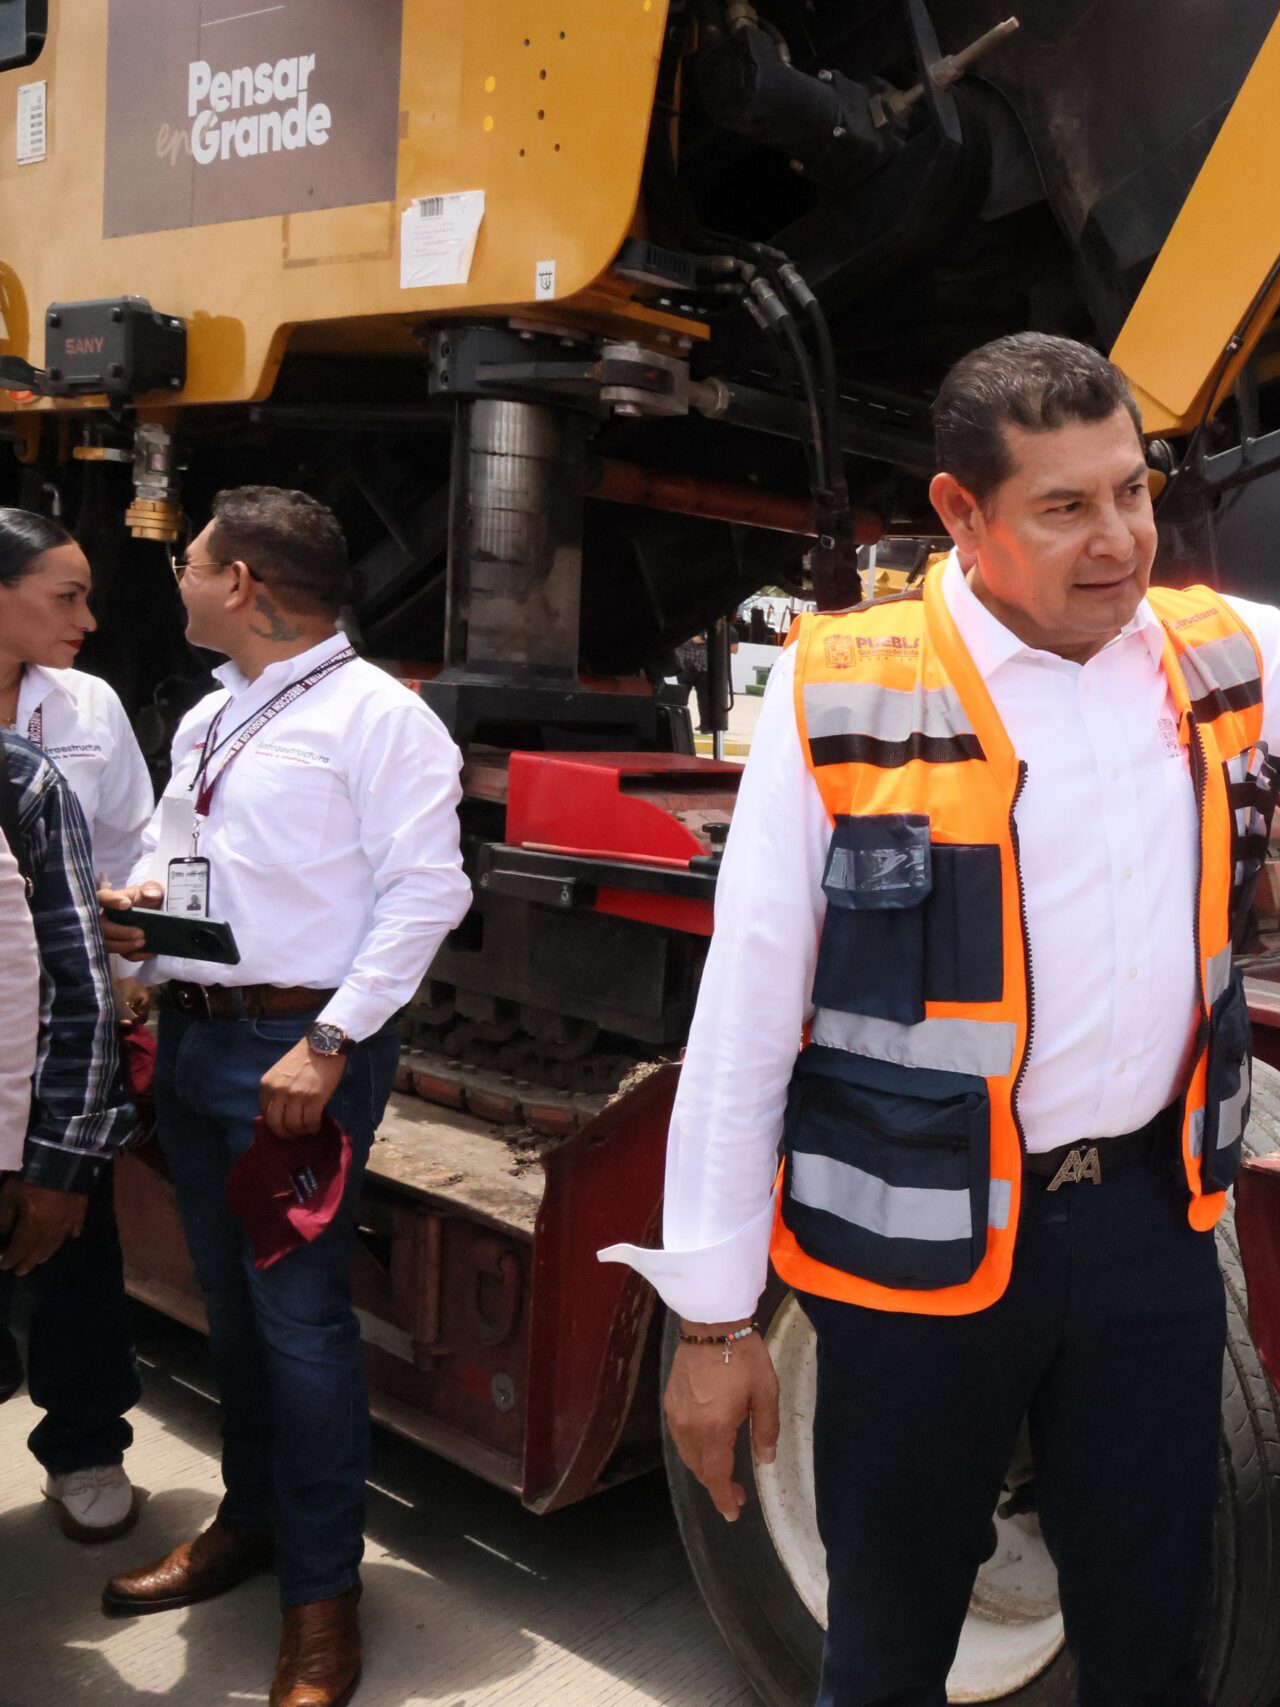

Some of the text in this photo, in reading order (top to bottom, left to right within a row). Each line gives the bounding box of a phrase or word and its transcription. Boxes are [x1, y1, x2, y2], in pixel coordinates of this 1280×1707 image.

[188, 53, 315, 117] Pensar
[191, 91, 332, 165] Grande
[64, 336, 105, 355] SANY
